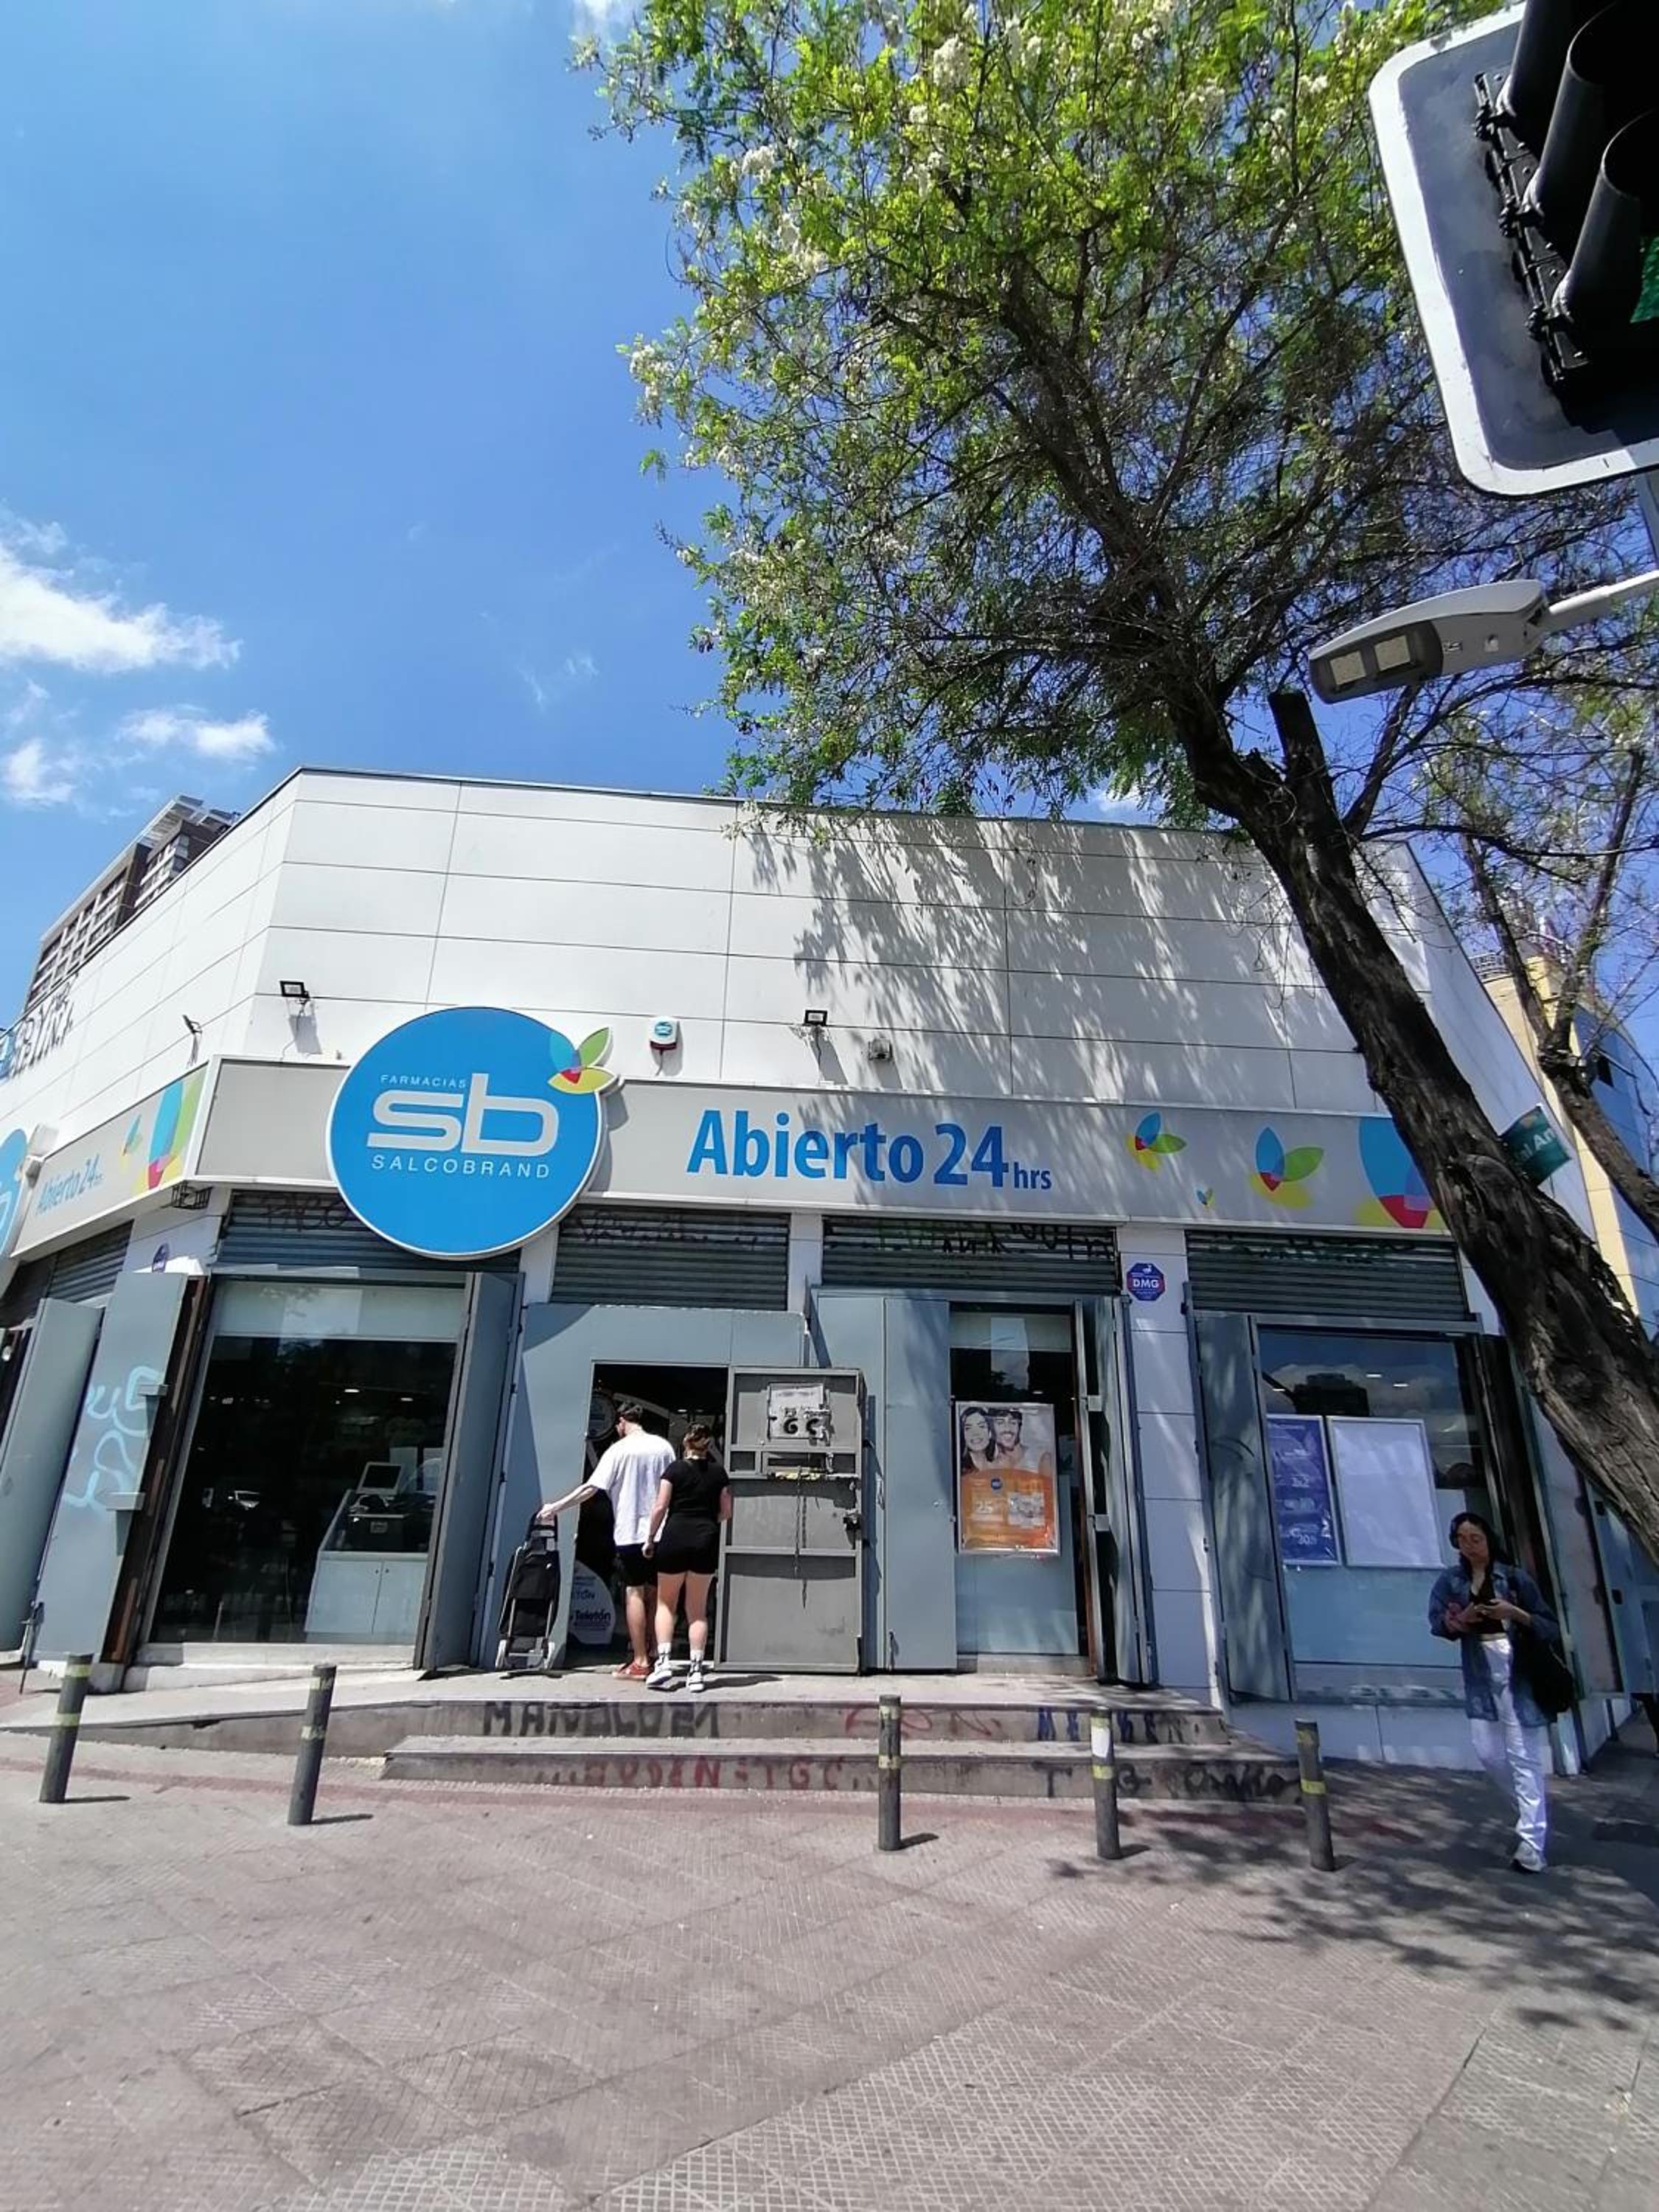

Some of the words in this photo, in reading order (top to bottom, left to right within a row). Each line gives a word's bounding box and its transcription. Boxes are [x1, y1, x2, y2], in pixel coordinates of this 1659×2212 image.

[380, 1074, 467, 1088] FARMACIAS
[366, 1072, 560, 1158] sb
[686, 1108, 924, 1184] Abierto
[933, 1122, 1009, 1189] 24
[1013, 1161, 1052, 1190] hrs
[371, 1154, 550, 1178] SALCOBRAND
[1133, 1278, 1159, 1288] DMG
